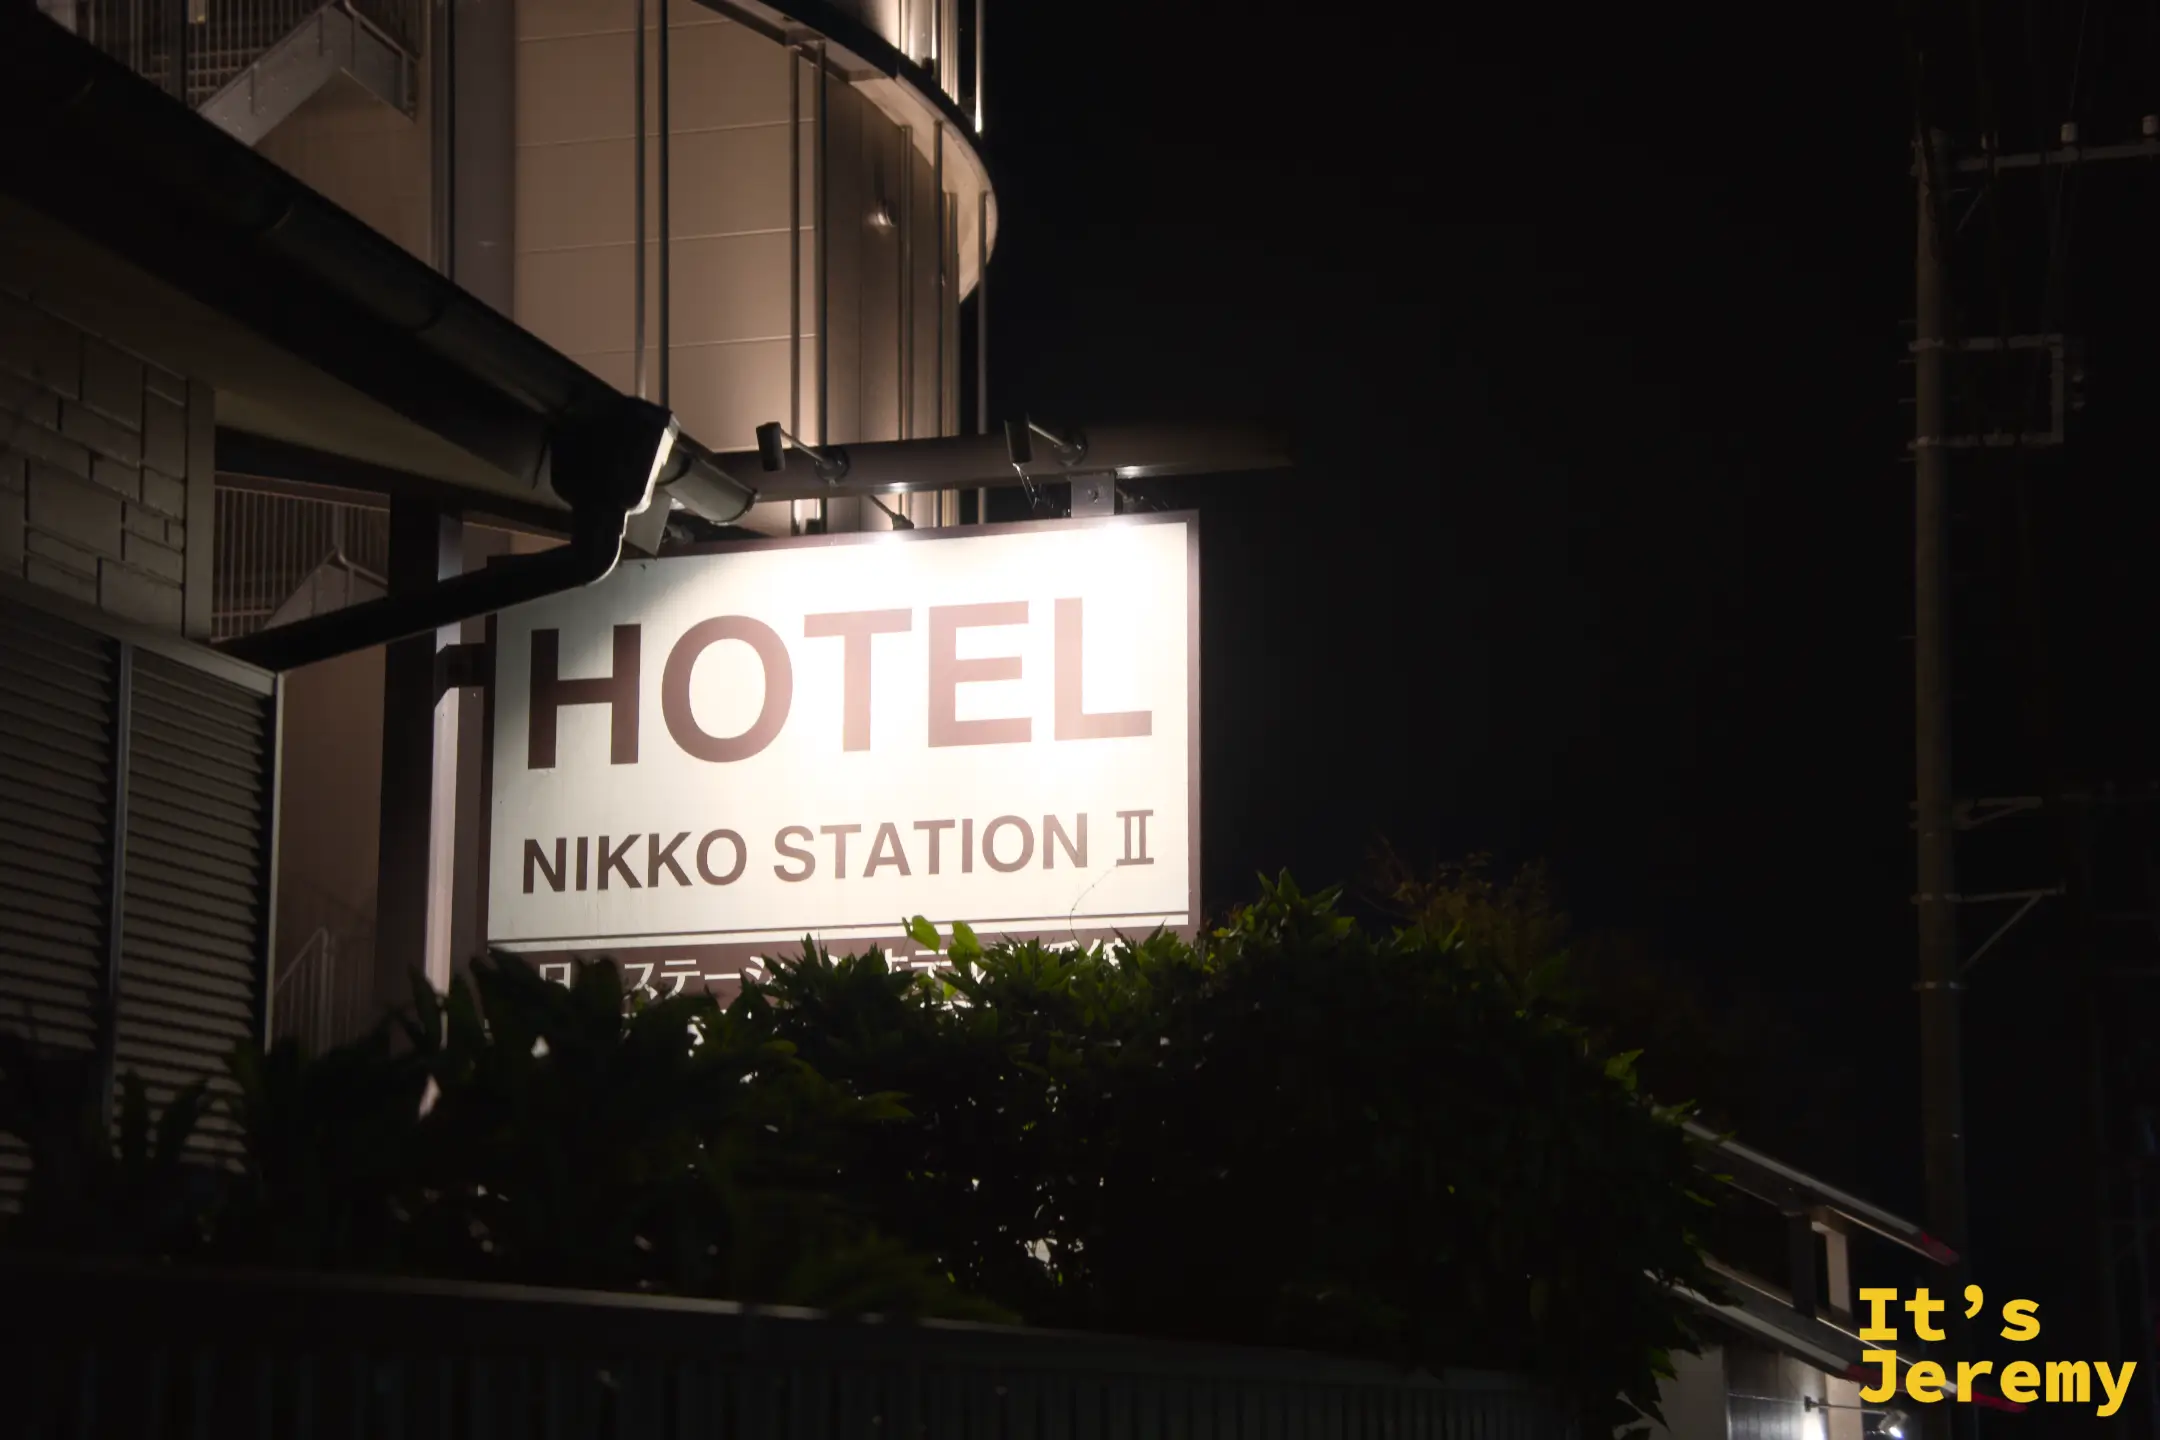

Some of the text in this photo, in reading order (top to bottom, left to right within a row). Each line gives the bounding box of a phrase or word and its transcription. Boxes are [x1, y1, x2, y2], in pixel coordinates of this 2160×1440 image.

[527, 597, 1153, 770] HOTEL
[522, 828, 748, 895] NIKKO
[773, 812, 1089, 884] STATION
